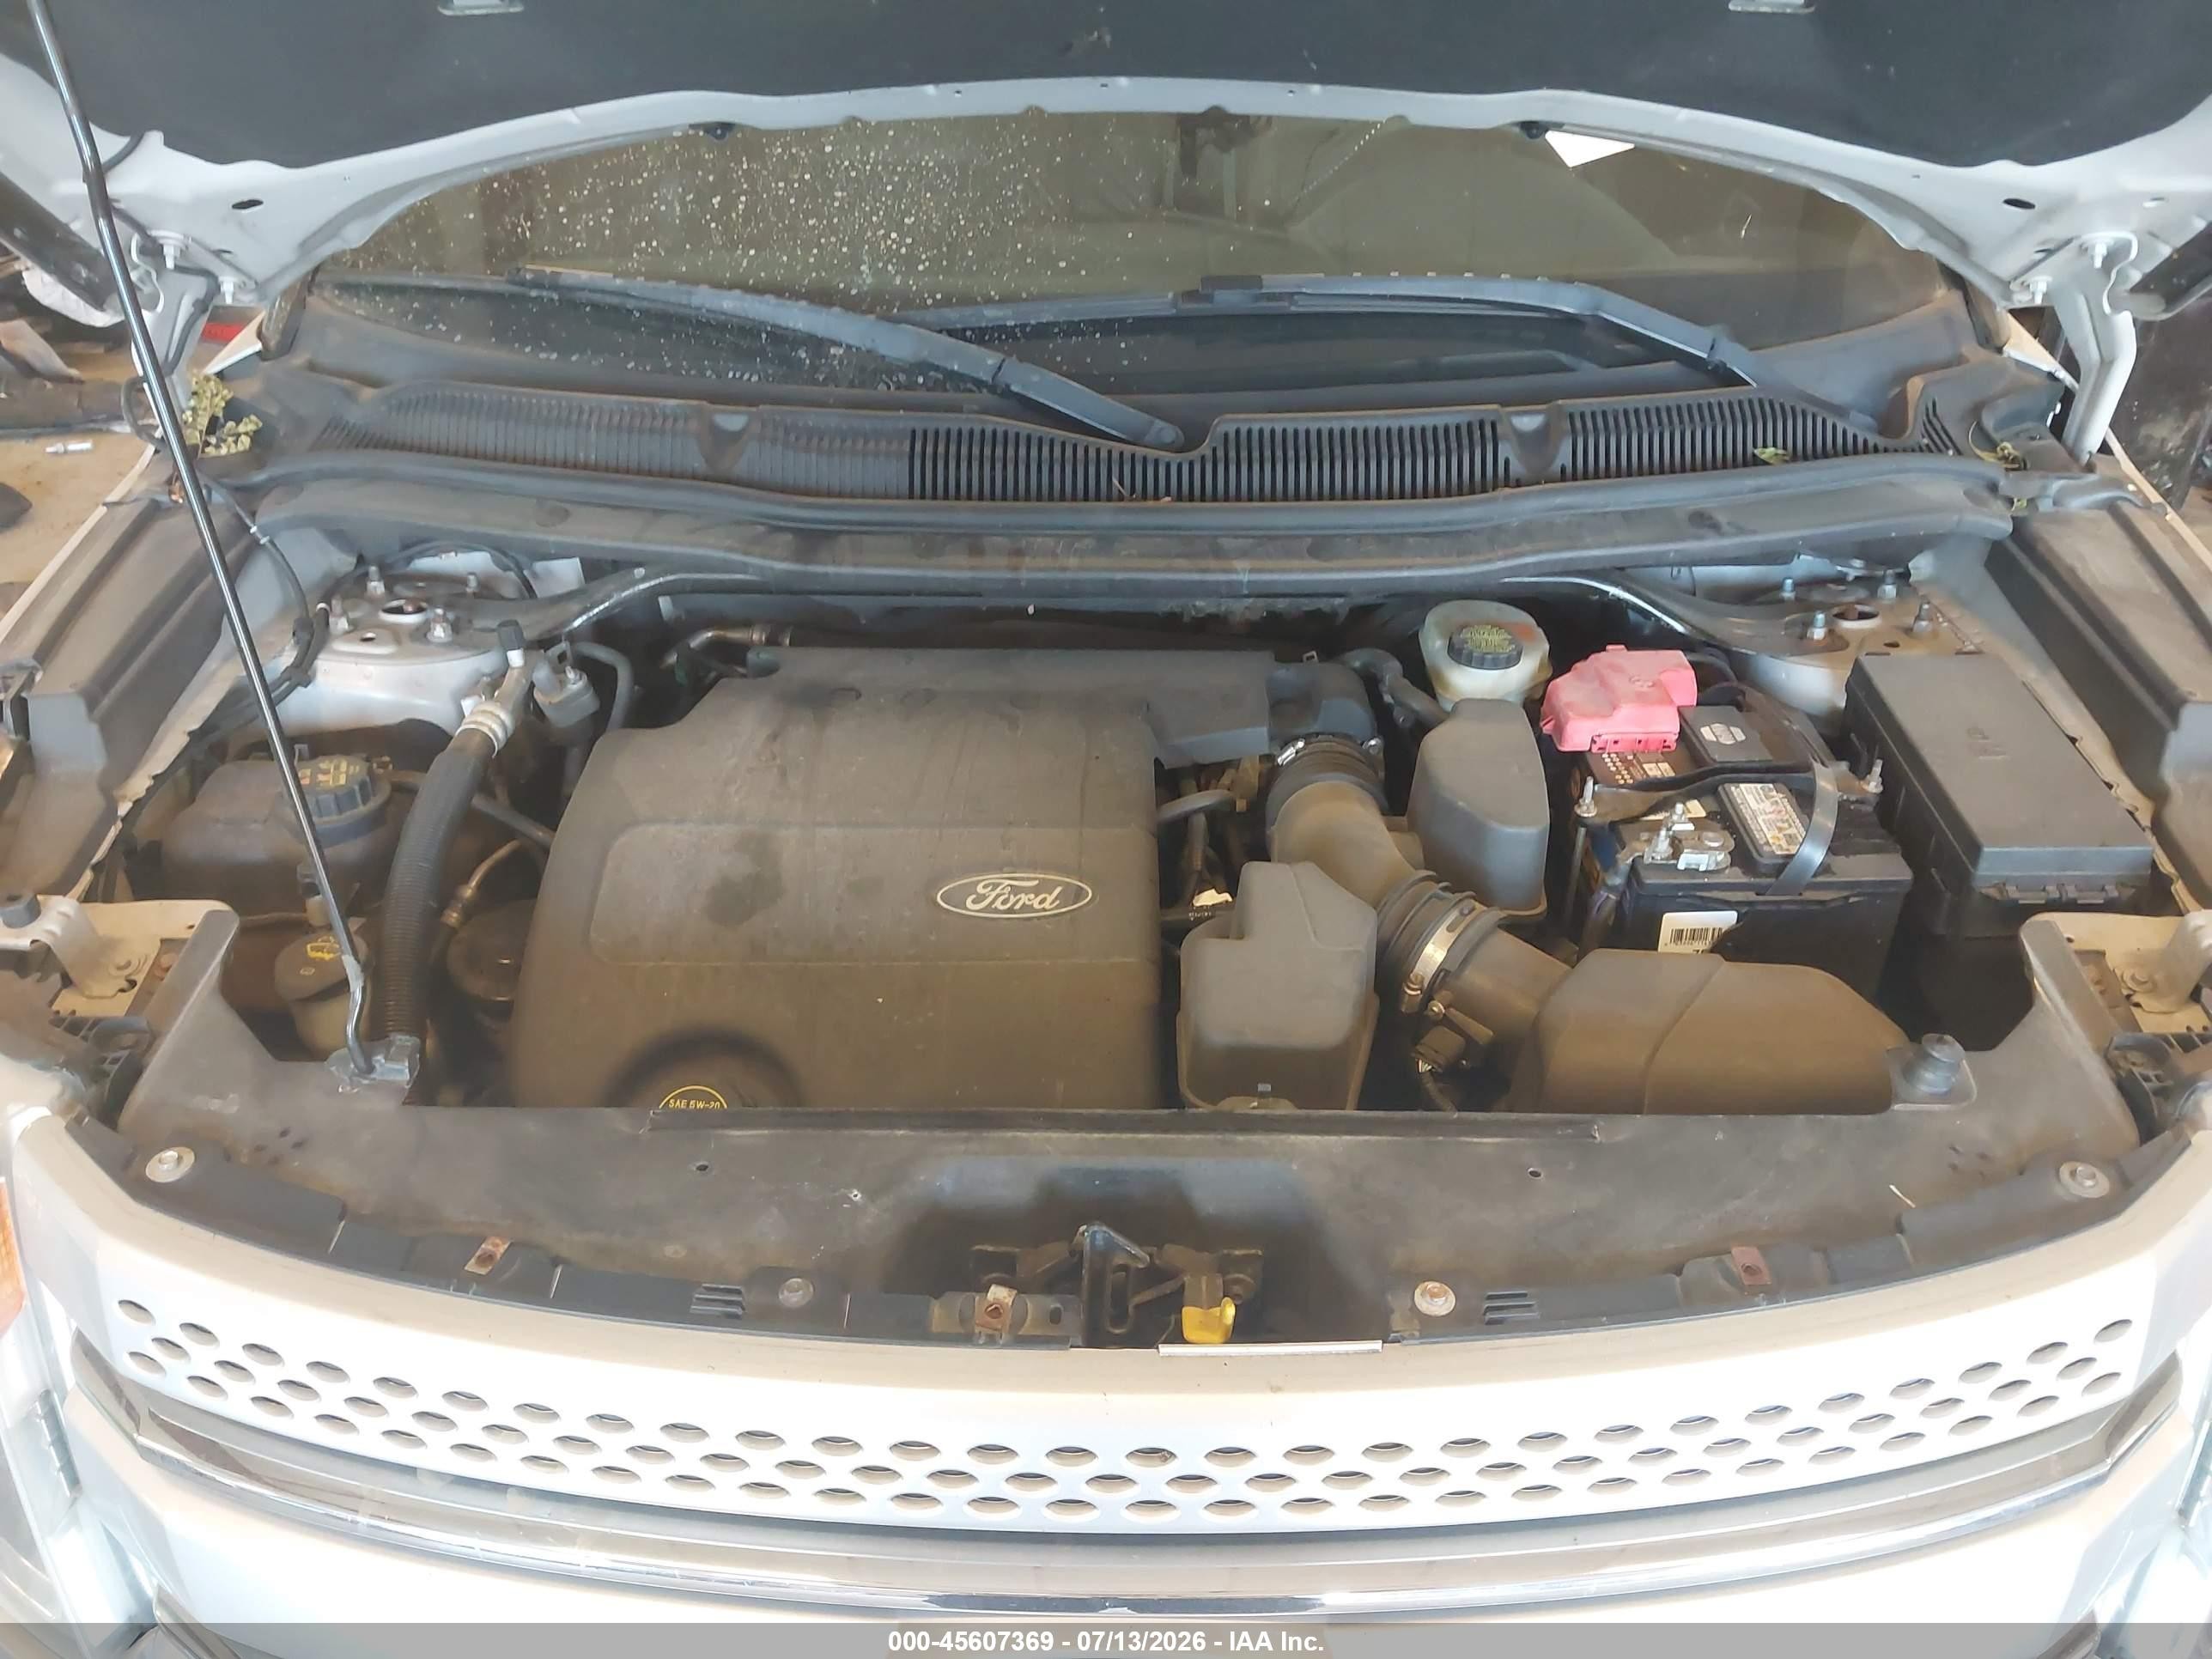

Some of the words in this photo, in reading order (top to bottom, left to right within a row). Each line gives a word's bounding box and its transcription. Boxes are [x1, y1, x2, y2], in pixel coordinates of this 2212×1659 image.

[965, 878, 1063, 911] Ford
[668, 1098, 688, 1109] SAE
[689, 1099, 721, 1110] 5W-20
